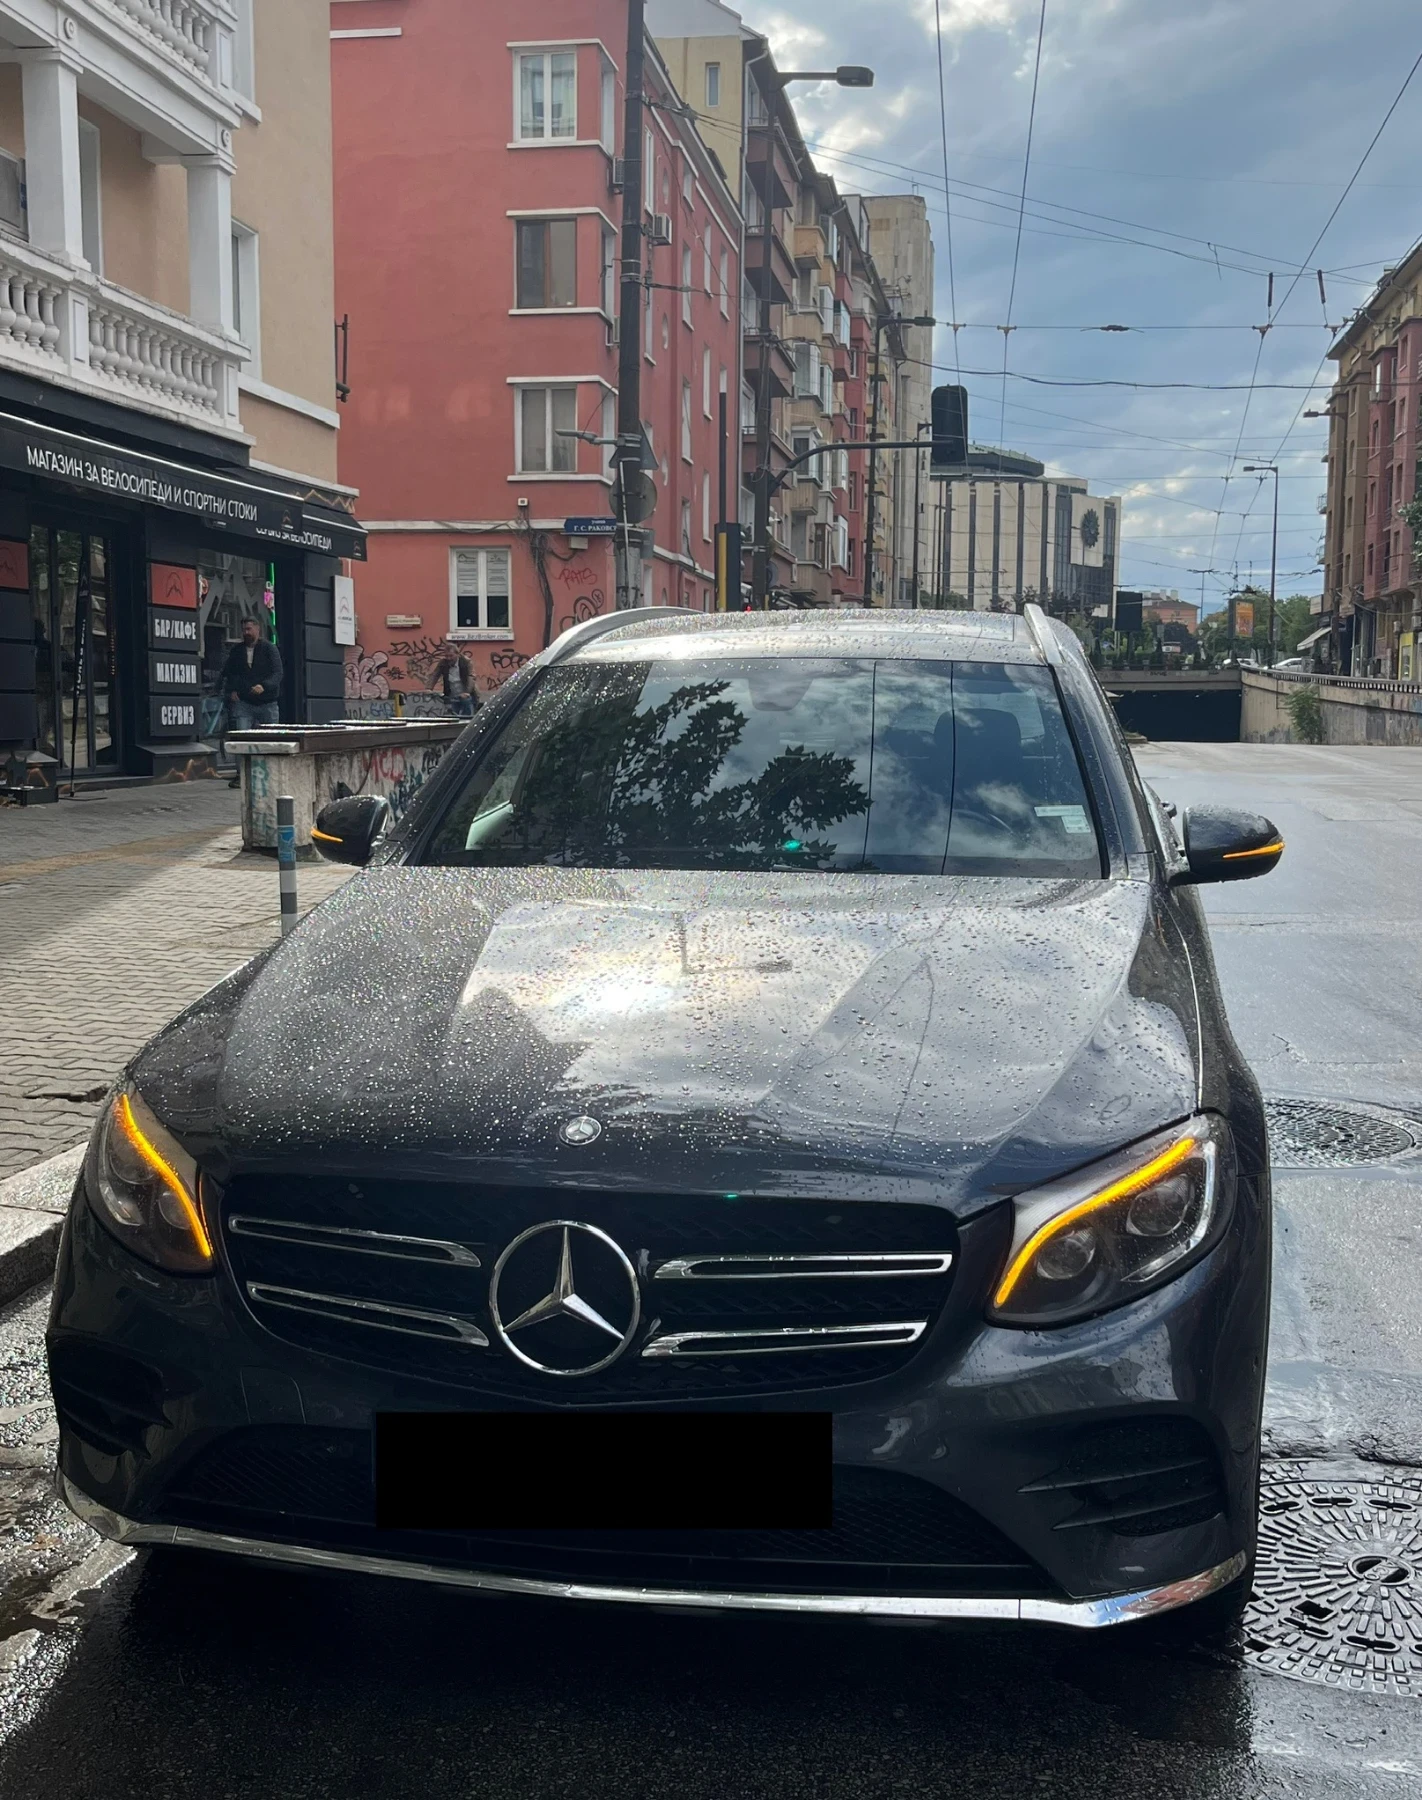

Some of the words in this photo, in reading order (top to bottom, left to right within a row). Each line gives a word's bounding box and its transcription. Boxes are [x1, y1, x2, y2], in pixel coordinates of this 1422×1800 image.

[27, 445, 83, 479] МАГАЗИН
[85, 464, 100, 484] ЗА
[101, 467, 172, 503] ВЕЛОСИПЕДИ
[173, 486, 182, 504] И
[183, 490, 226, 515] СПОРТНИ
[227, 500, 257, 522] СТОКИ
[155, 618, 197, 640] БАР/КАФЕ
[156, 662, 197, 684] МАГАЗИН
[161, 705, 195, 726] СЕРВИЗ
